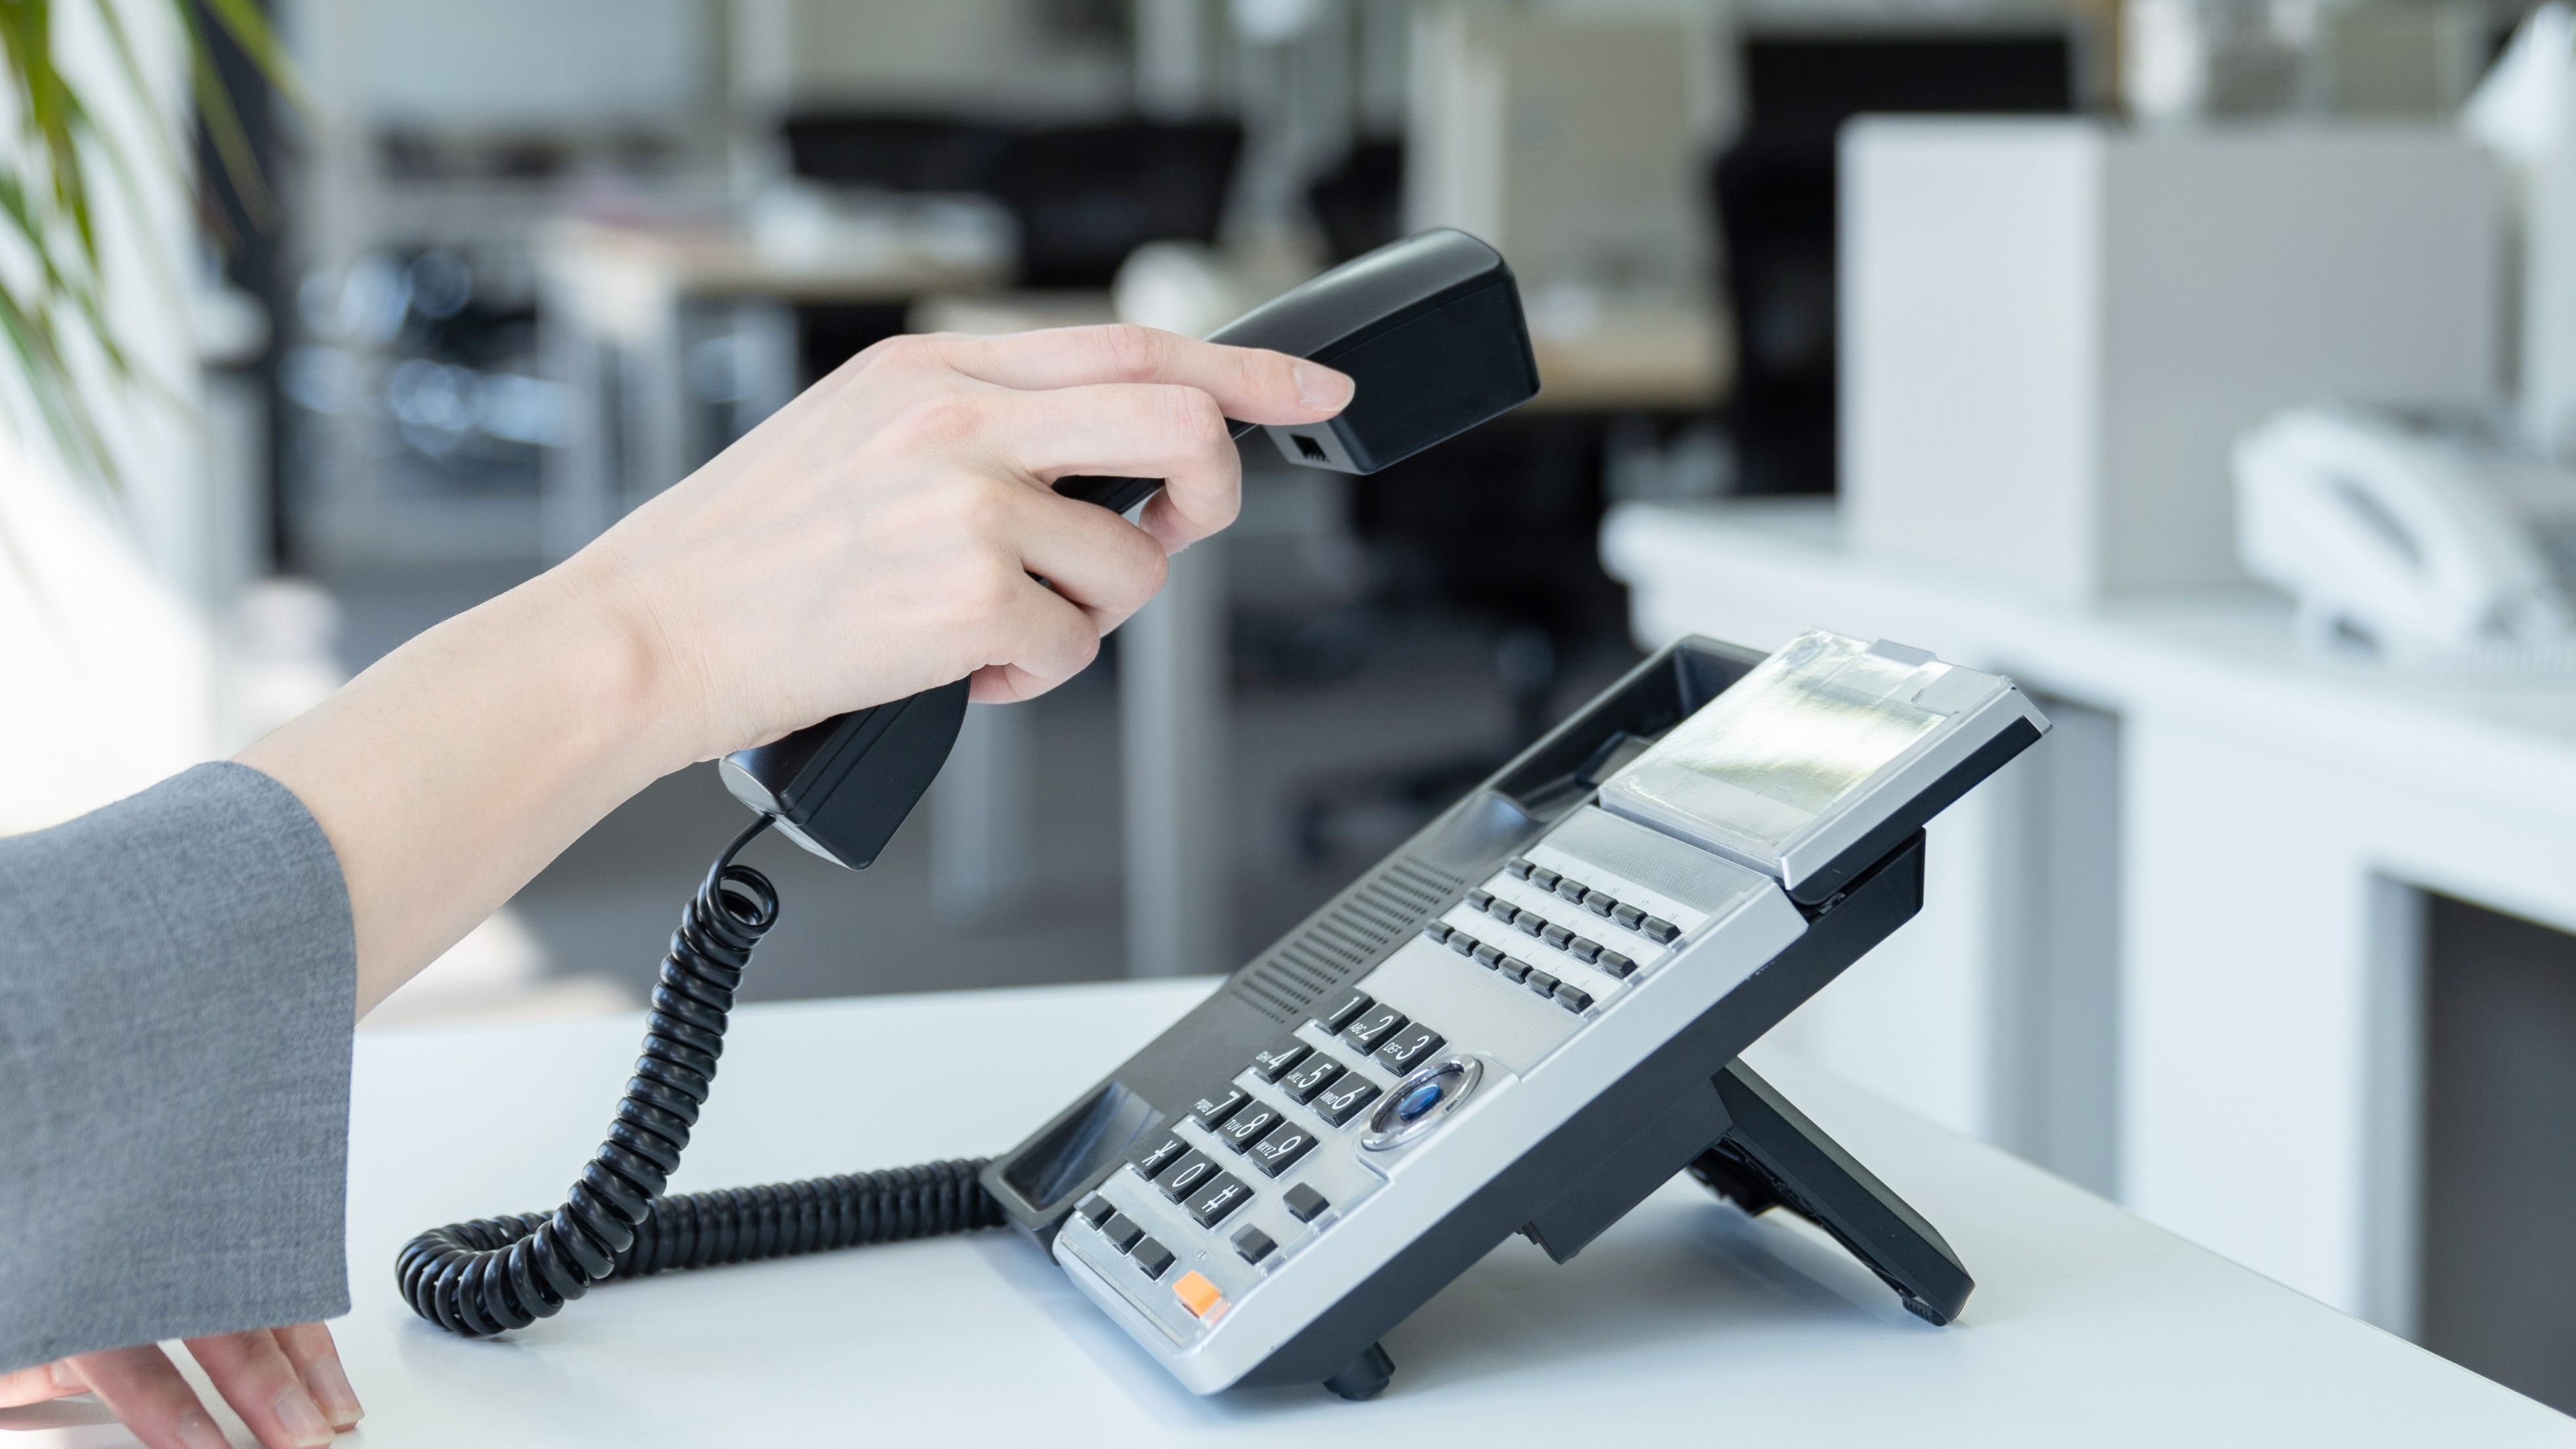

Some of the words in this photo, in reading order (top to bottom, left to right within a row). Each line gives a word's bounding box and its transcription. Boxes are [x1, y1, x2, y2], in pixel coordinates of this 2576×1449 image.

[1328, 996, 1360, 1021] 1
[1349, 1022, 1367, 1034] ABC
[1359, 1015, 1393, 1040] 2
[1256, 1051, 1273, 1063] GHI
[1268, 1046, 1300, 1070] 4
[1383, 1042, 1402, 1053] DEF
[1395, 1035, 1429, 1060] 3
[1286, 1071, 1303, 1084] JKL
[1298, 1063, 1333, 1088] 5
[1205, 1090, 1240, 1116] 7
[1319, 1090, 1338, 1105] MNO
[1332, 1086, 1366, 1110] 6
[1224, 1118, 1242, 1132] TUV
[1235, 1113, 1269, 1137] 8
[1256, 1141, 1277, 1156] WXYZ
[1267, 1135, 1301, 1160] 9
[1172, 1162, 1206, 1187] 0
